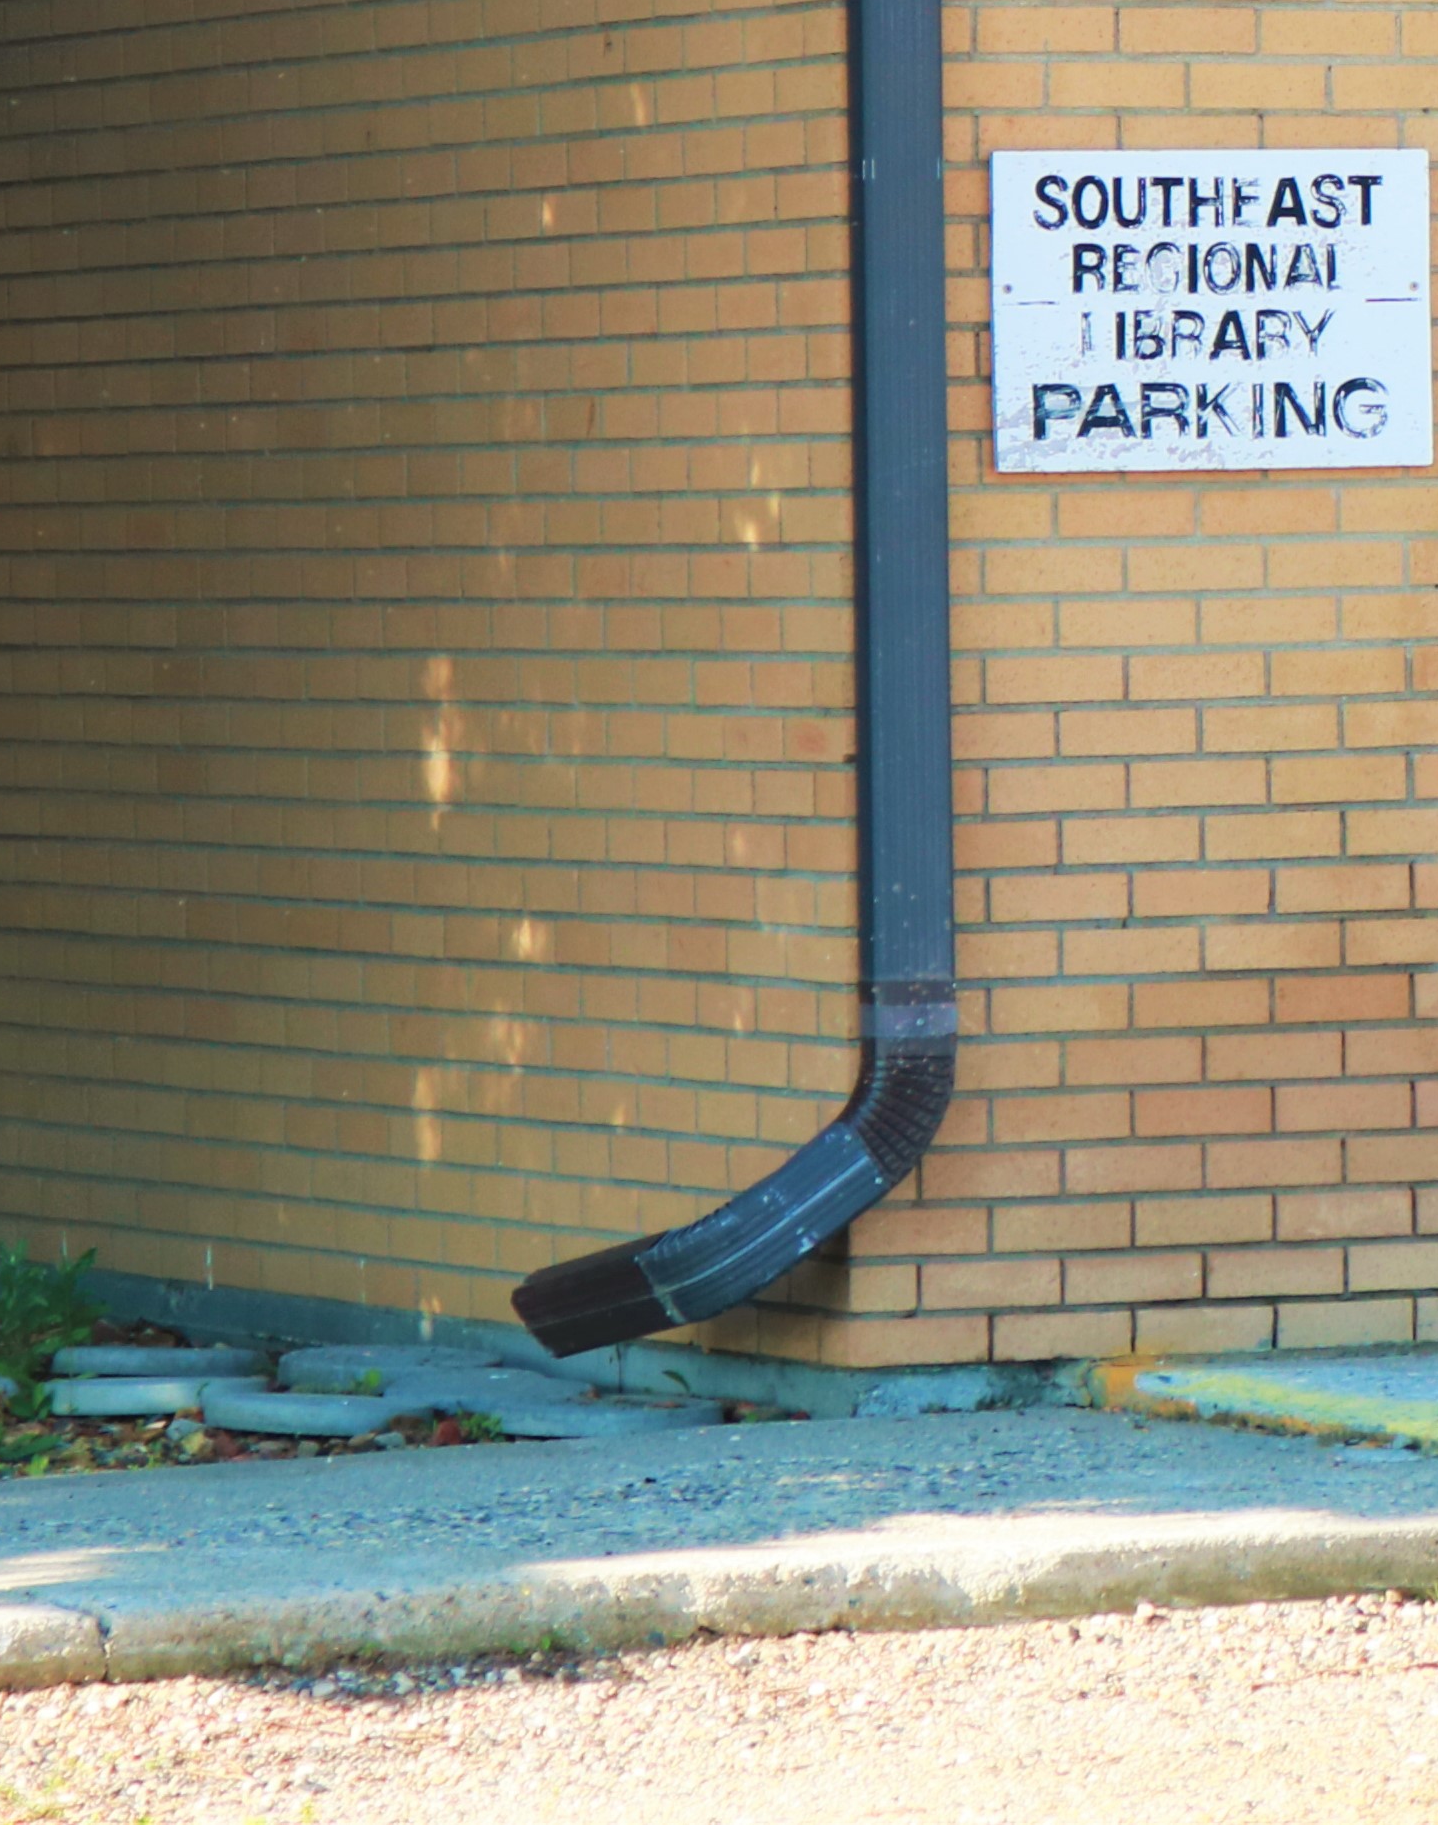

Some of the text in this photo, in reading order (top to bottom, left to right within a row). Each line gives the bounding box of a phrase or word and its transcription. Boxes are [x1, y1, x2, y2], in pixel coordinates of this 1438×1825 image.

[1033, 173, 1383, 231] SOUTHEAST
[1072, 241, 1341, 295] REGIONAL
[1032, 377, 1388, 441] PARKING
